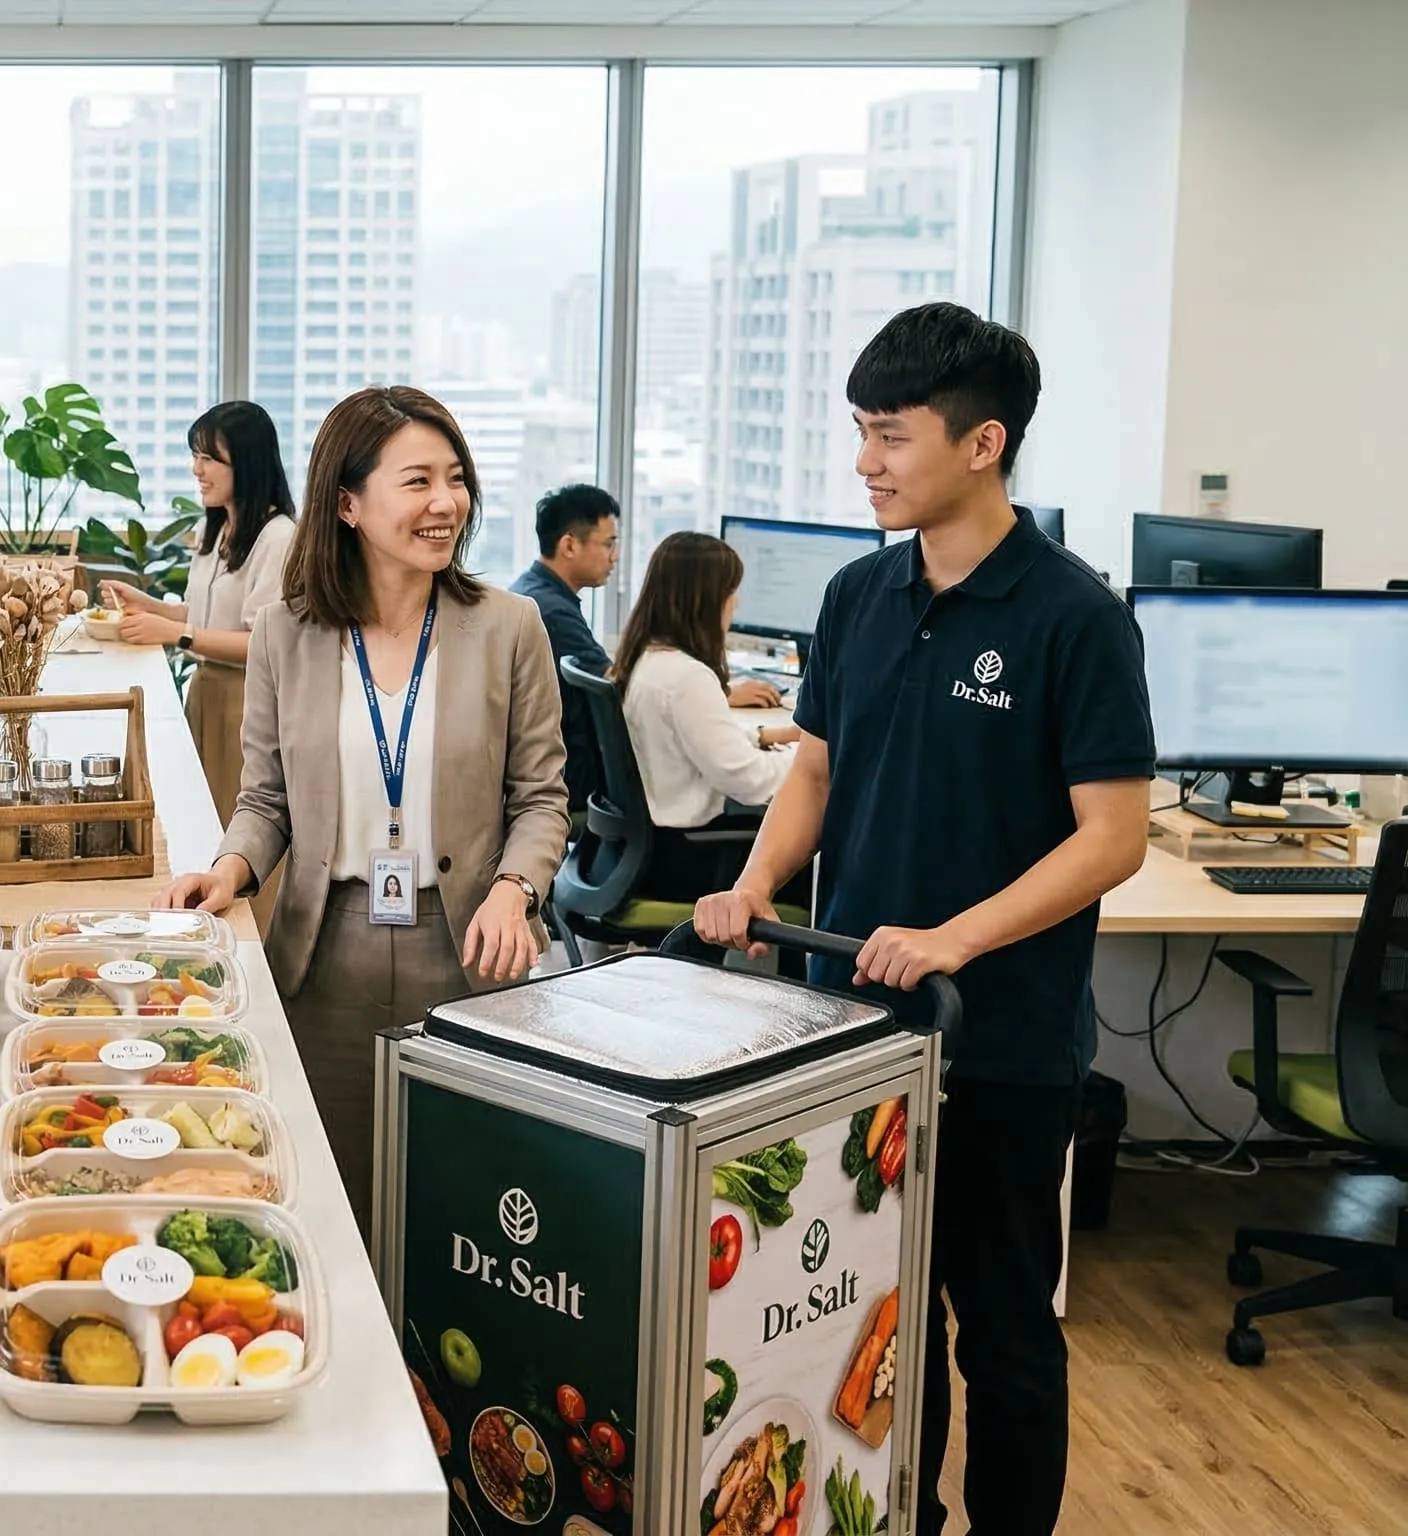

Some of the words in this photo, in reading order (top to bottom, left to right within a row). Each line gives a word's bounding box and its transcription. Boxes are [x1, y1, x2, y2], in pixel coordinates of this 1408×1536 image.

[452, 1232, 504, 1288] Dr.
[510, 1257, 586, 1320] Salt
[762, 1303, 802, 1344] Dr.
[807, 1269, 861, 1323] Salt
